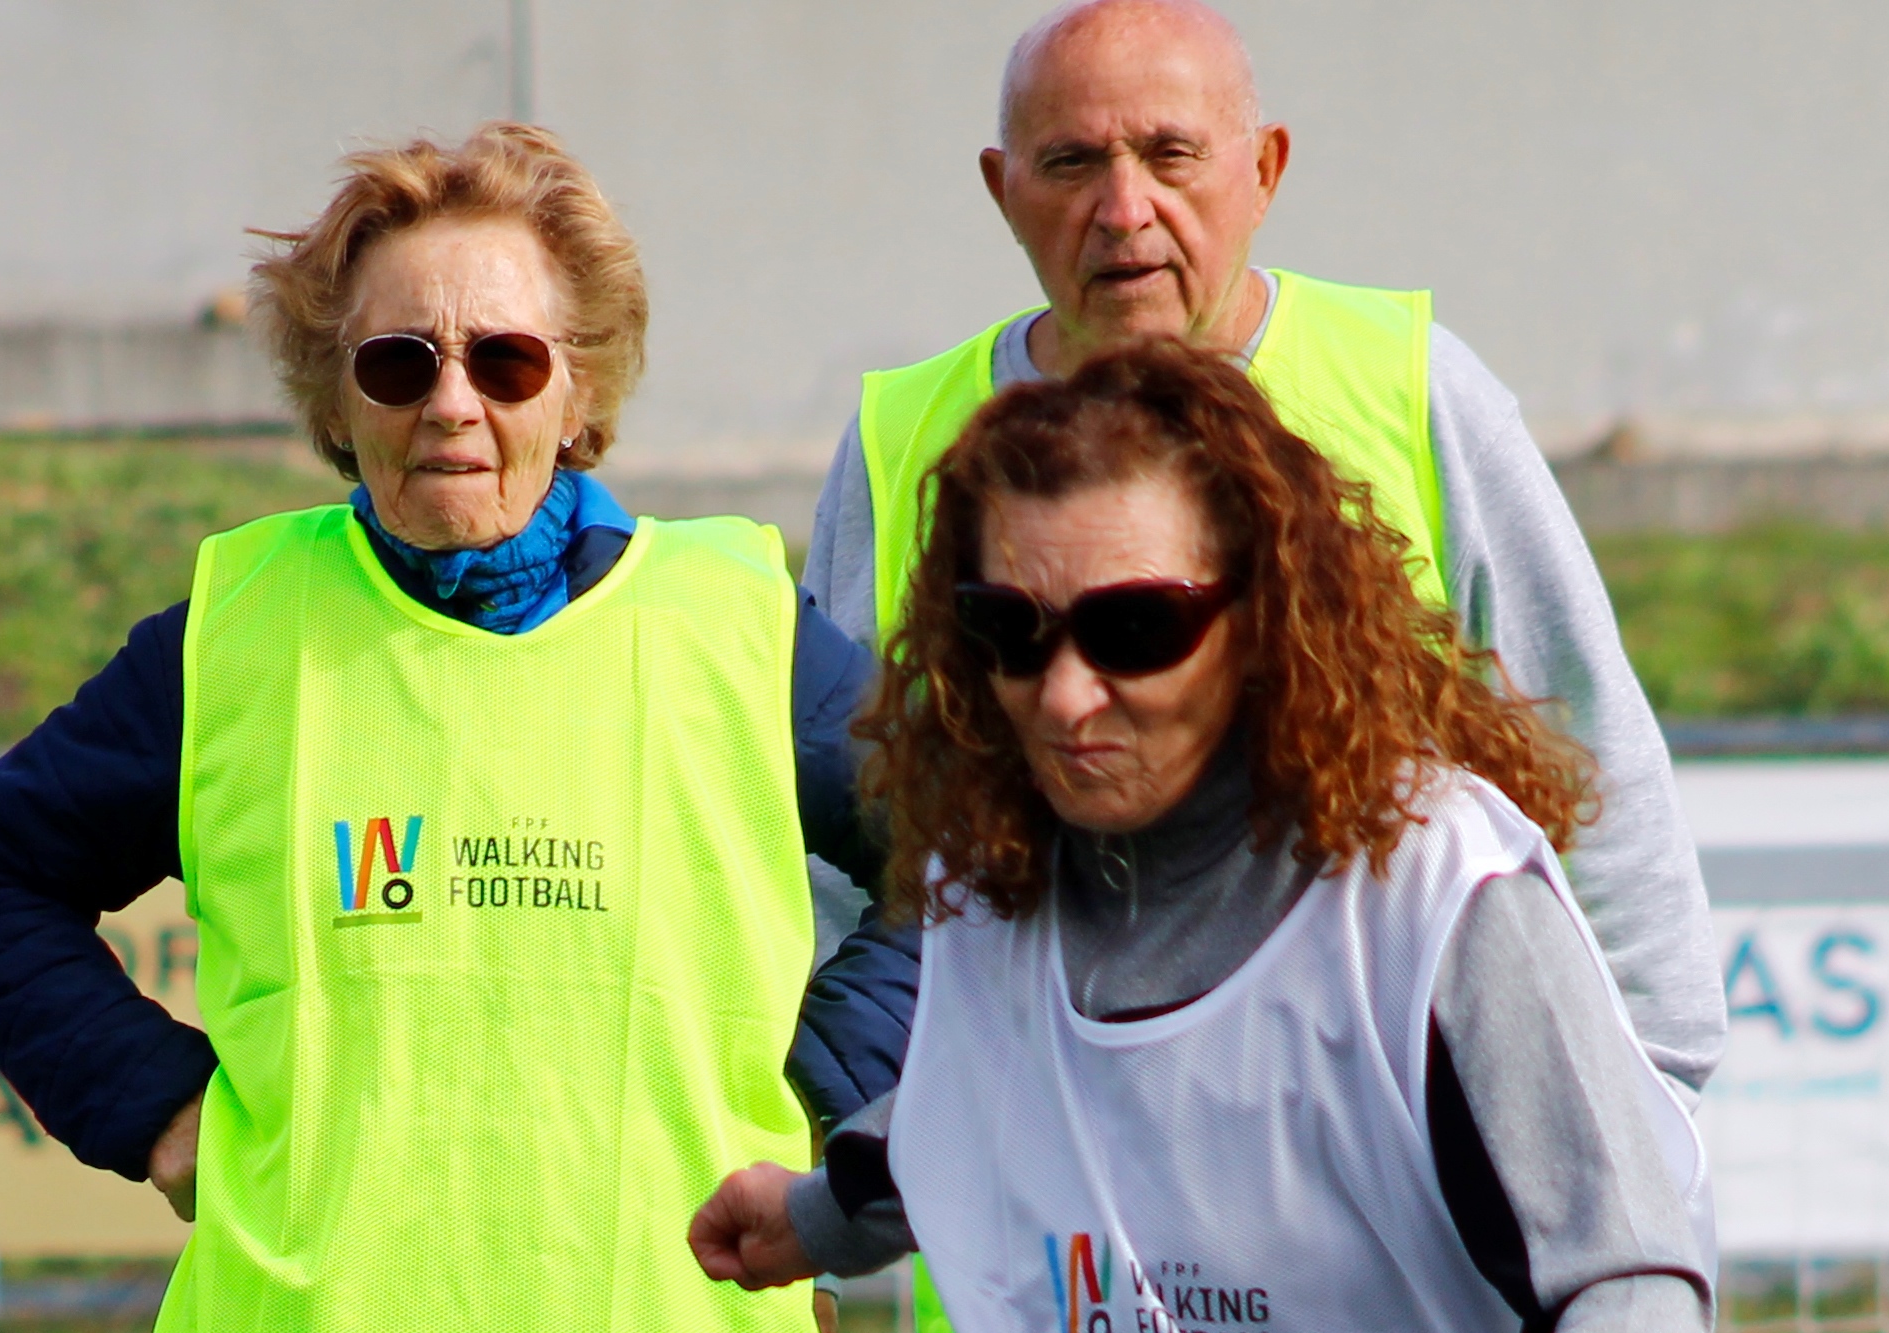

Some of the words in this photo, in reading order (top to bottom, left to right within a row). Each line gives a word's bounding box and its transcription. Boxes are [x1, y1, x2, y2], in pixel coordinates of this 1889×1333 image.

[452, 836, 604, 870] WALKING
[450, 877, 608, 912] FOOTBALL
[1723, 930, 1881, 1038] AS
